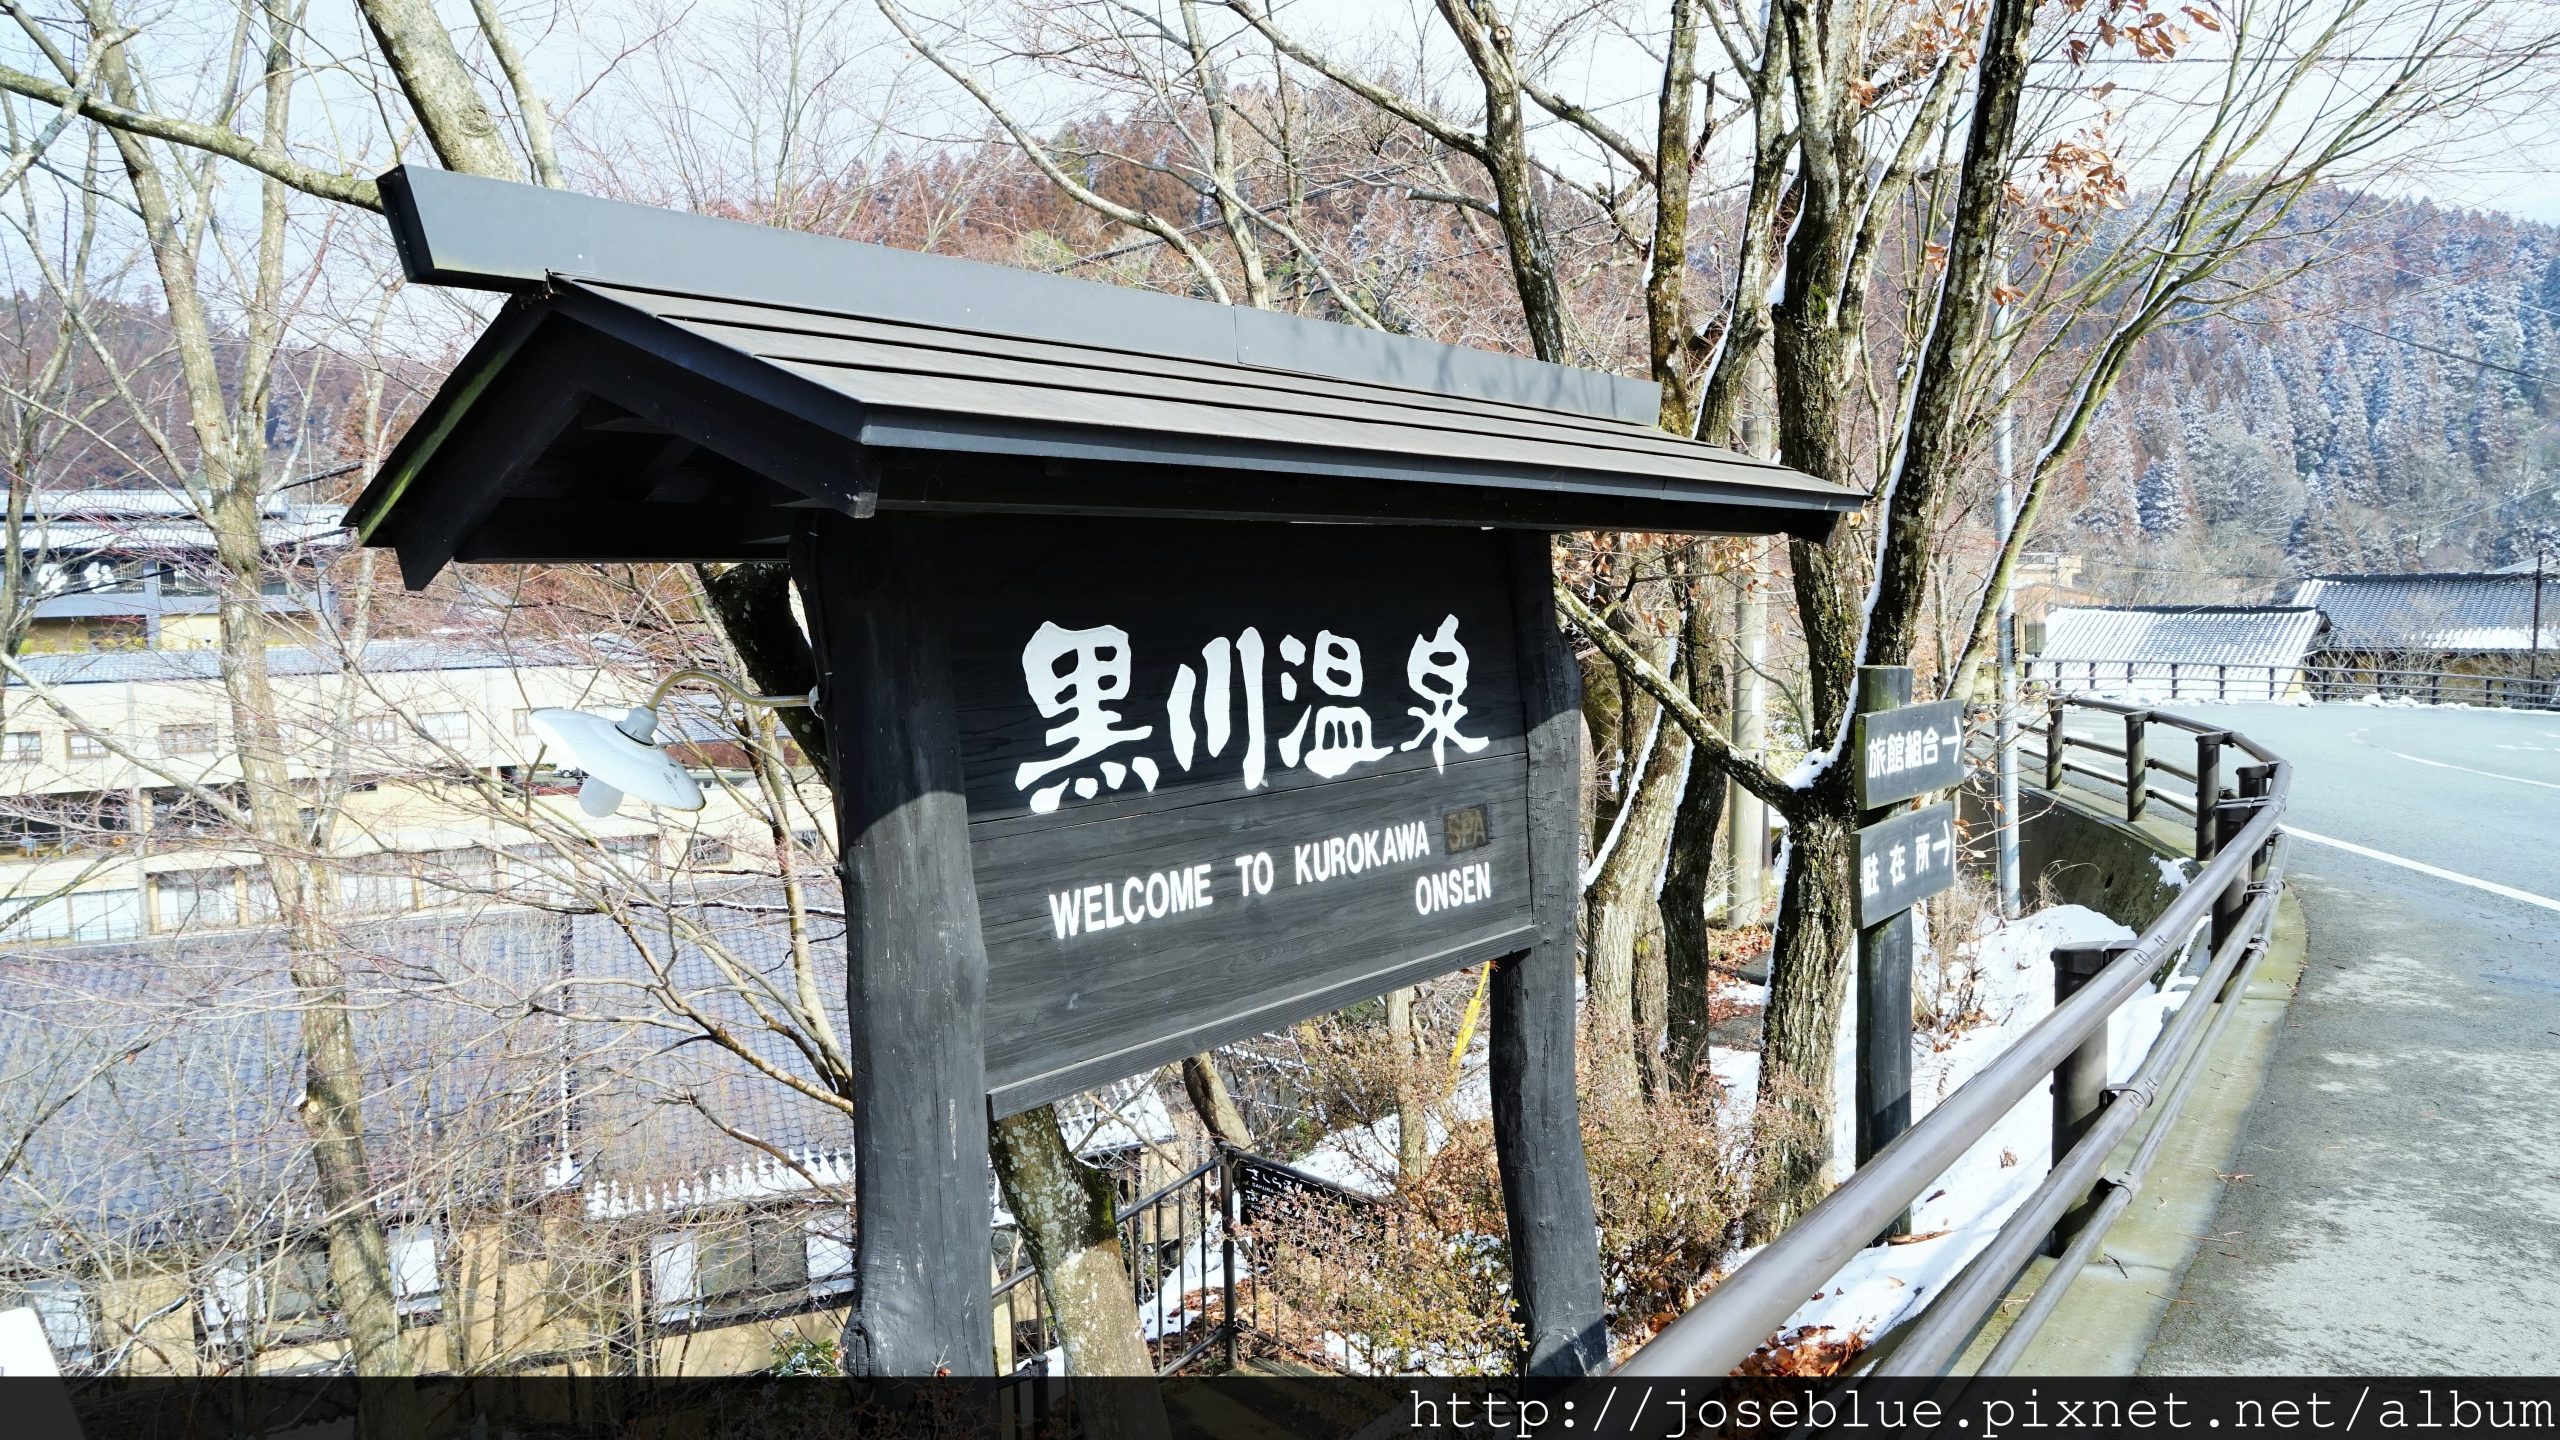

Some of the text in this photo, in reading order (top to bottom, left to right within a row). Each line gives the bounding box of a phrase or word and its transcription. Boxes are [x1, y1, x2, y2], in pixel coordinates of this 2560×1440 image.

[1015, 613, 1490, 814] 黒川温泉
[1868, 727, 1939, 778] 旅館組合
[1049, 809, 1486, 940] WELCOME TO KUROKAWA SPA
[1416, 862, 1491, 916] ONSEN
[1863, 832, 1930, 898] 駐在所
